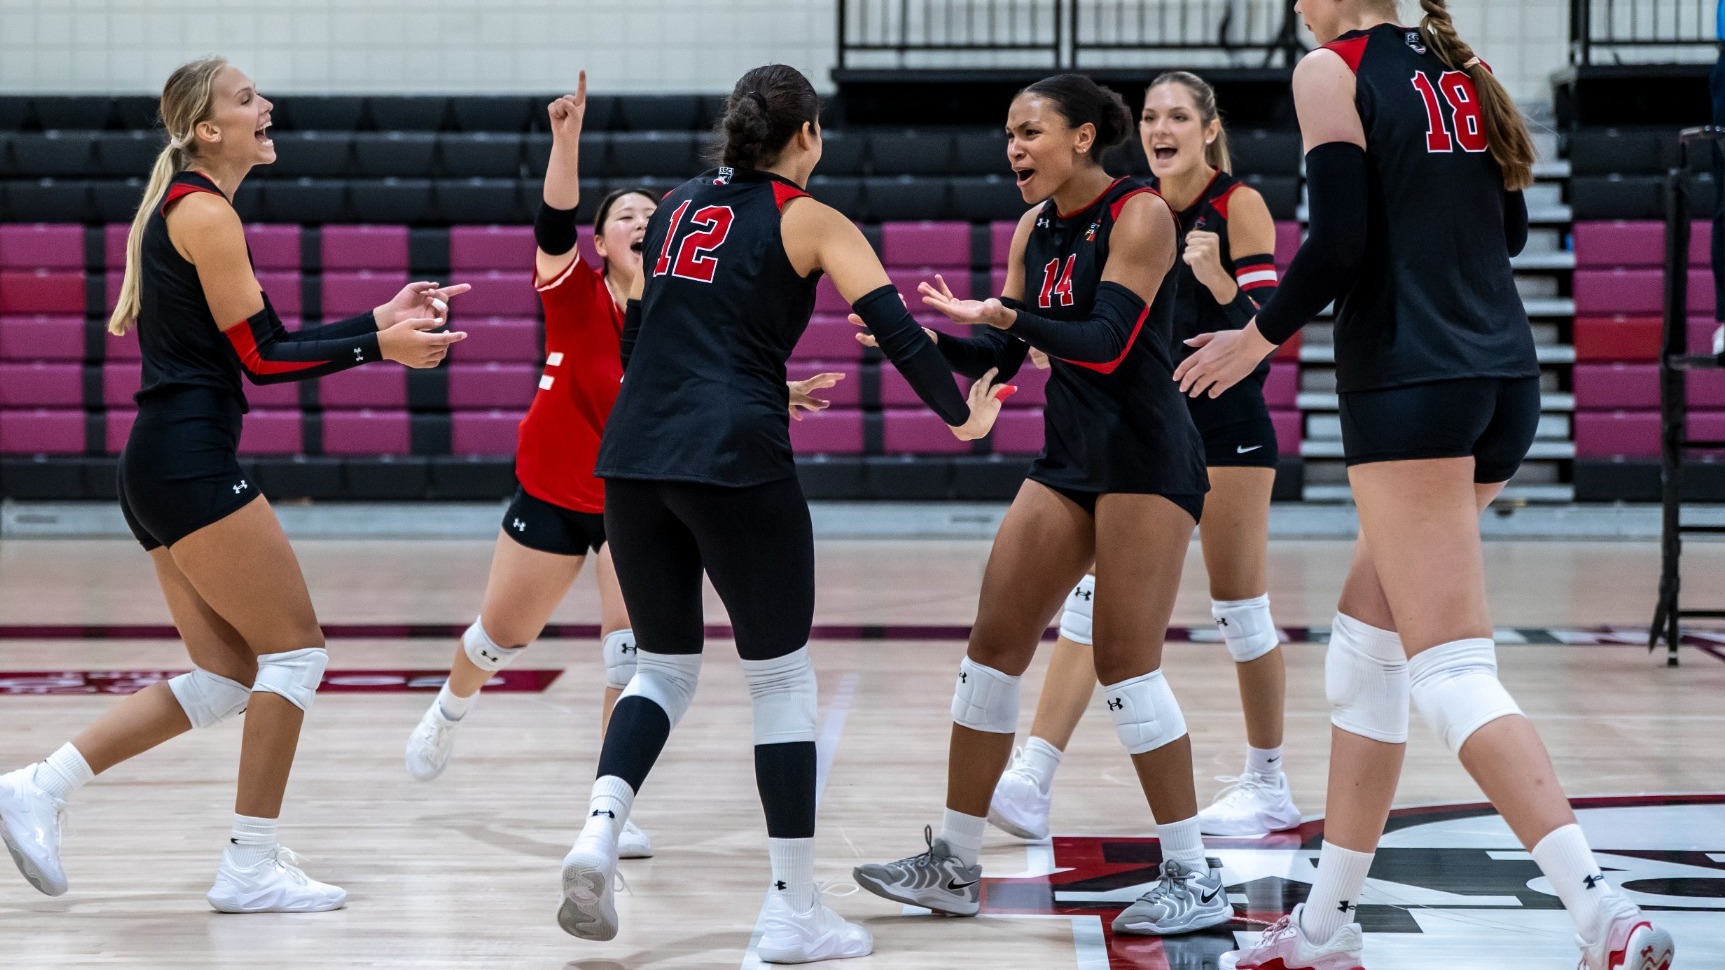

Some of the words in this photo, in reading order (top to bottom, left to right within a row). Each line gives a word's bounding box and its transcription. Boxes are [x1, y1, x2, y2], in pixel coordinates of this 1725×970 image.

[1411, 70, 1488, 153] 18
[653, 200, 735, 283] 12
[1039, 253, 1076, 308] 14
